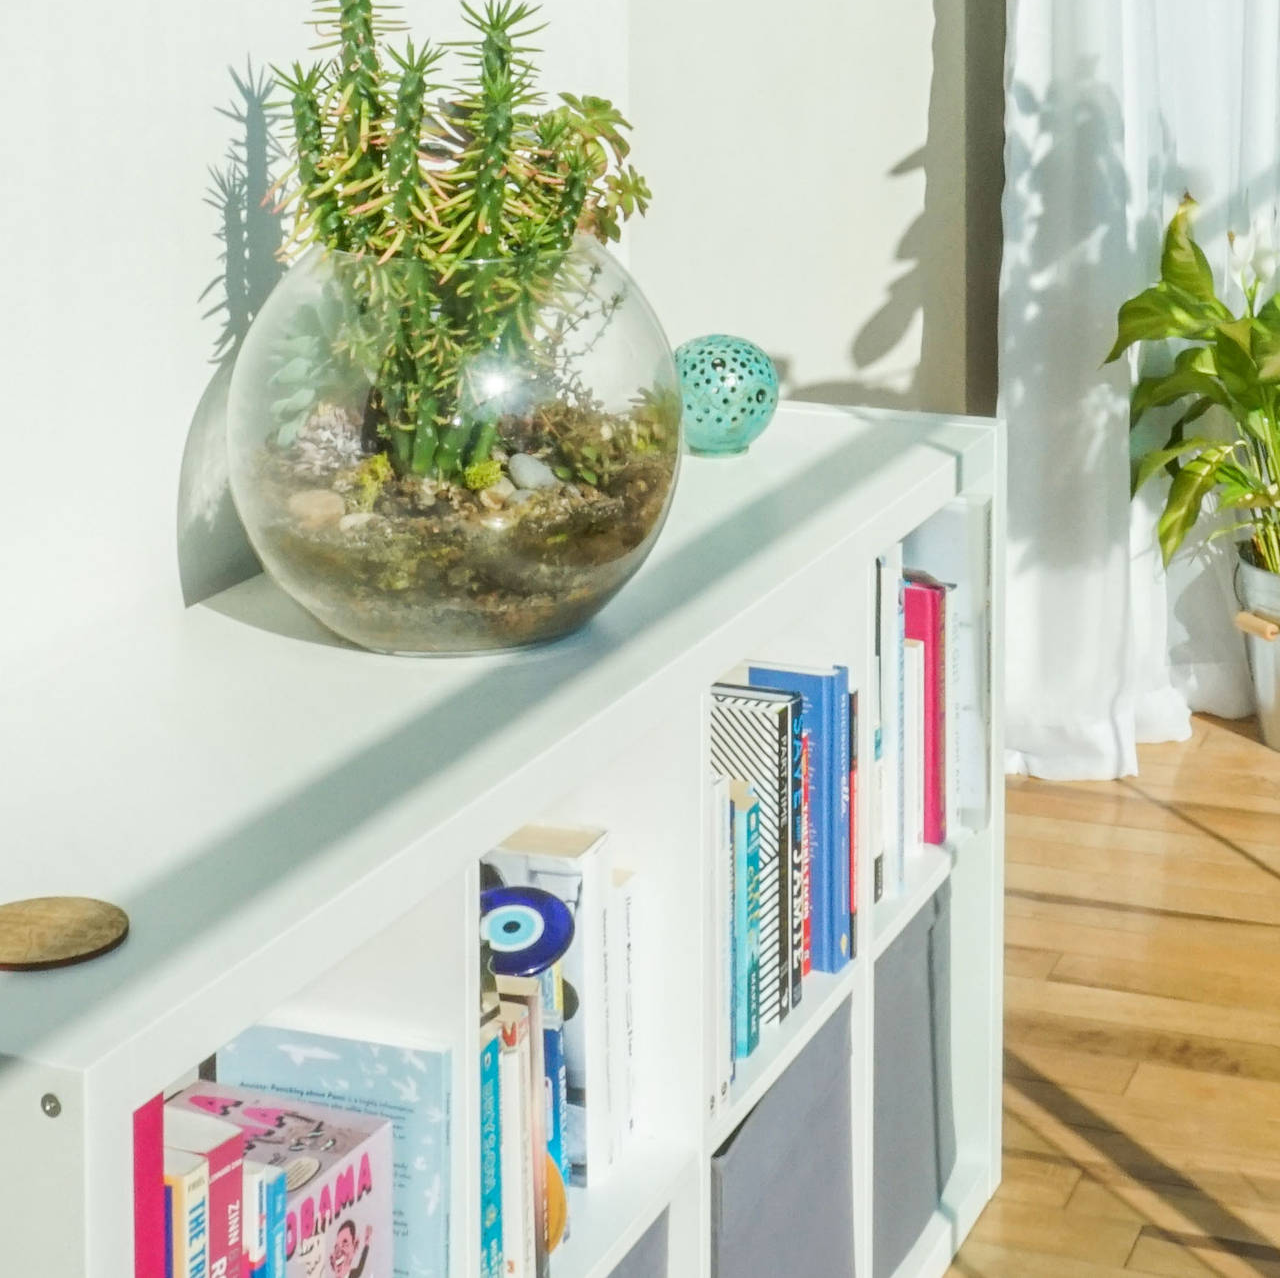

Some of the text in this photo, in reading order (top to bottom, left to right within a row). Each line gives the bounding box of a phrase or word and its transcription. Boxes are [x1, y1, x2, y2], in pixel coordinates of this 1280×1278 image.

[793, 715, 803, 810] SAVE
[793, 849, 803, 969] JAMIE
[559, 1065, 568, 1171] BARCELONA
[188, 1196, 206, 1249] THE
[227, 1199, 240, 1247] ZINN
